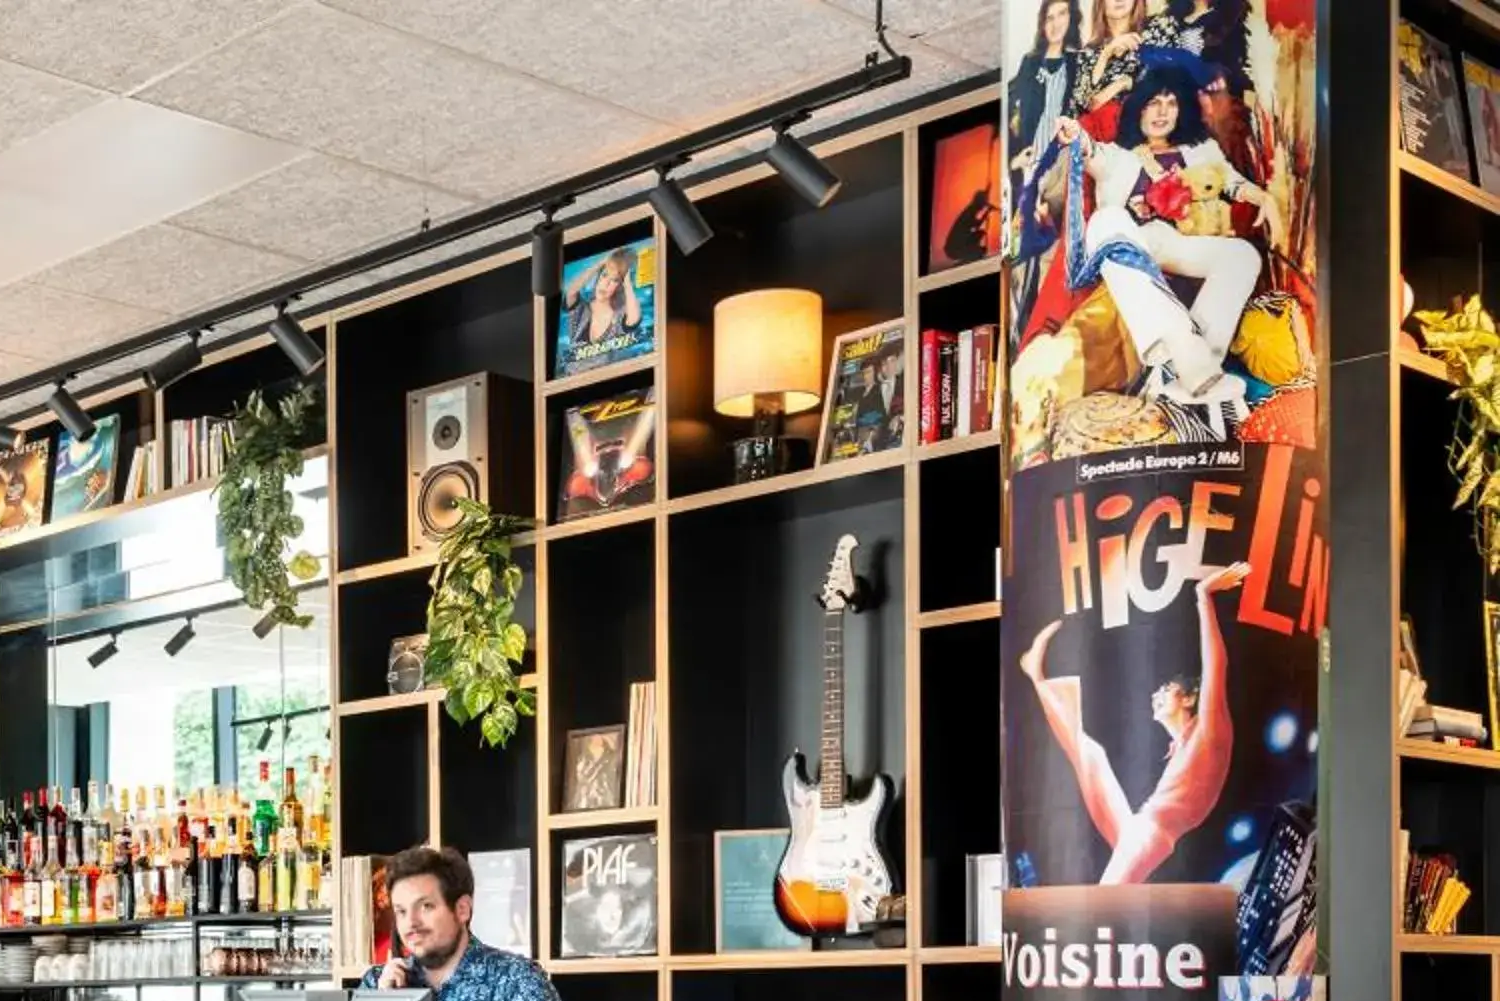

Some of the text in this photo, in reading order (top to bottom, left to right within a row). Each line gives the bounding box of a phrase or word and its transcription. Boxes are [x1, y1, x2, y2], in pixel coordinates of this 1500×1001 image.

[1080, 457, 1144, 480] Spectacle
[1145, 454, 1196, 469] Europe
[1198, 452, 1207, 464] 2
[1217, 451, 1240, 465] M6
[582, 843, 636, 889] PIAF
[1003, 926, 1208, 990] Voisine
